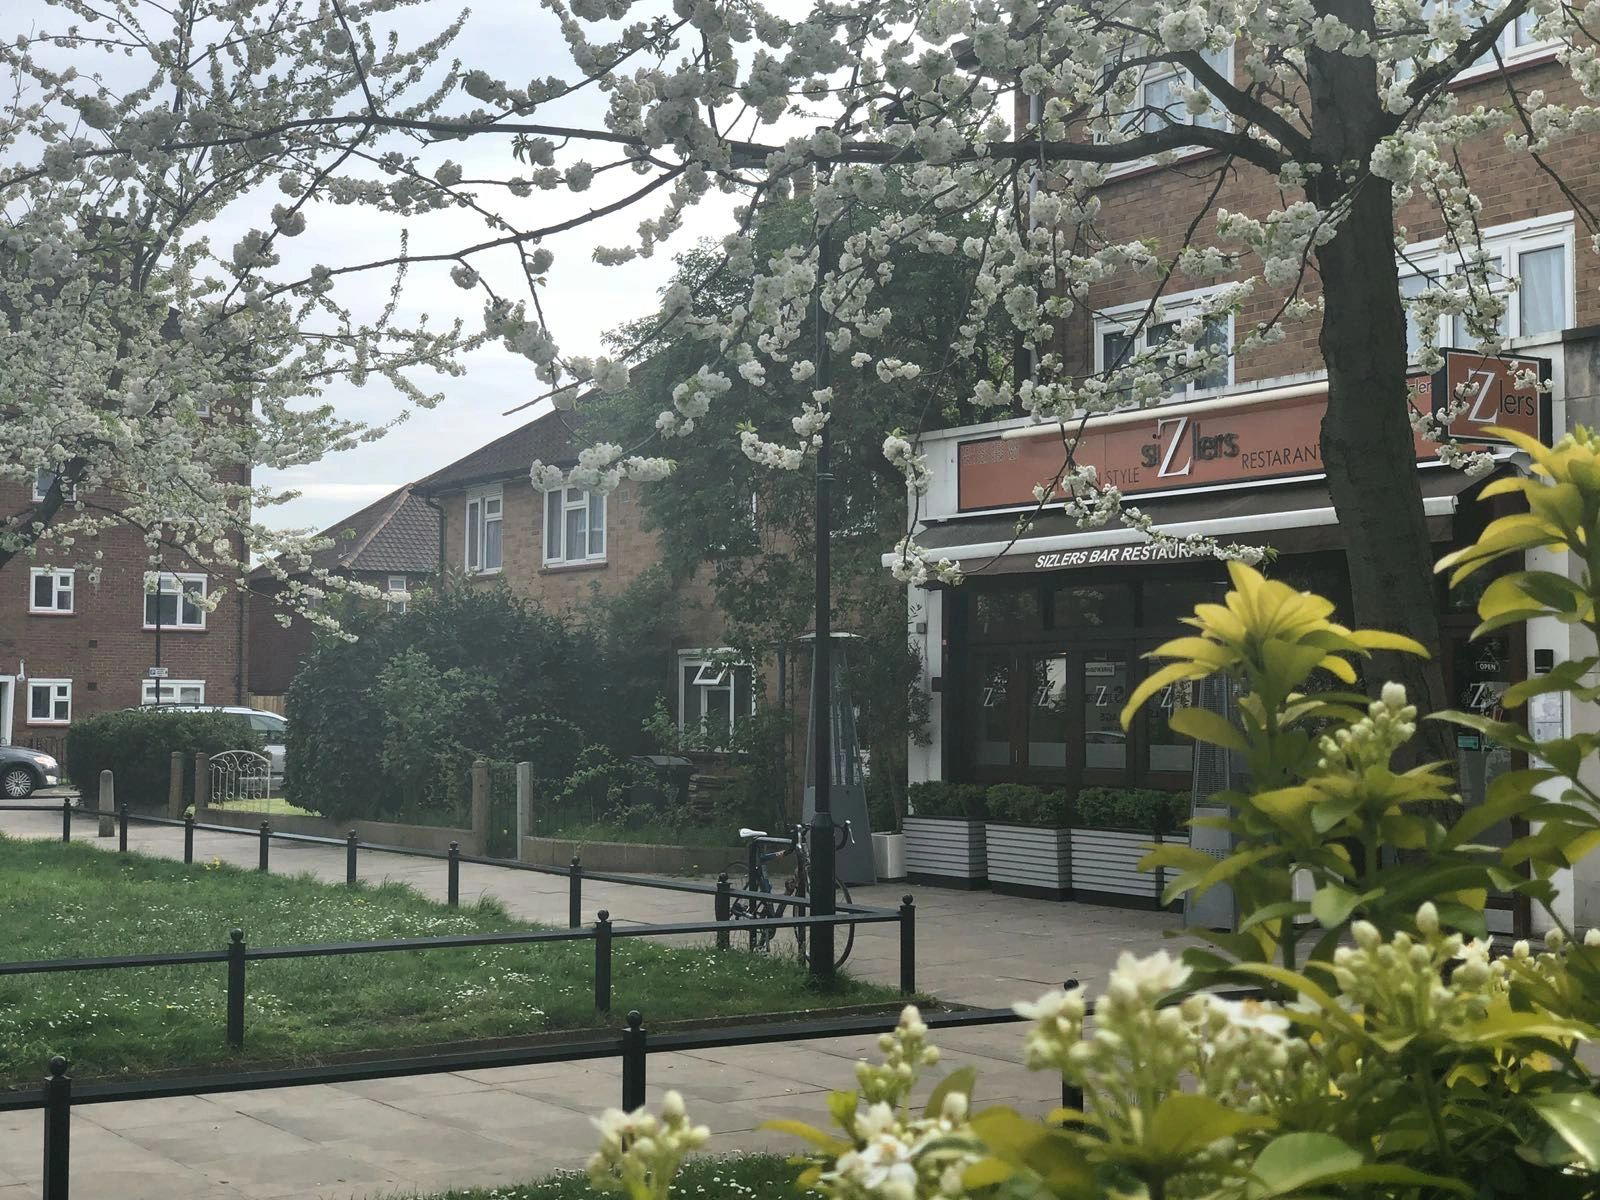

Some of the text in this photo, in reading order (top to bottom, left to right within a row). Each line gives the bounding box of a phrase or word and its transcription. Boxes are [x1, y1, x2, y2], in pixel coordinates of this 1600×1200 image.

[1106, 467, 1140, 485] STYLE
[1035, 551, 1088, 568] SIZLERS
[1089, 548, 1119, 563] BAR
[1480, 663, 1496, 671] OPEN
[1095, 685, 1107, 707] Z
